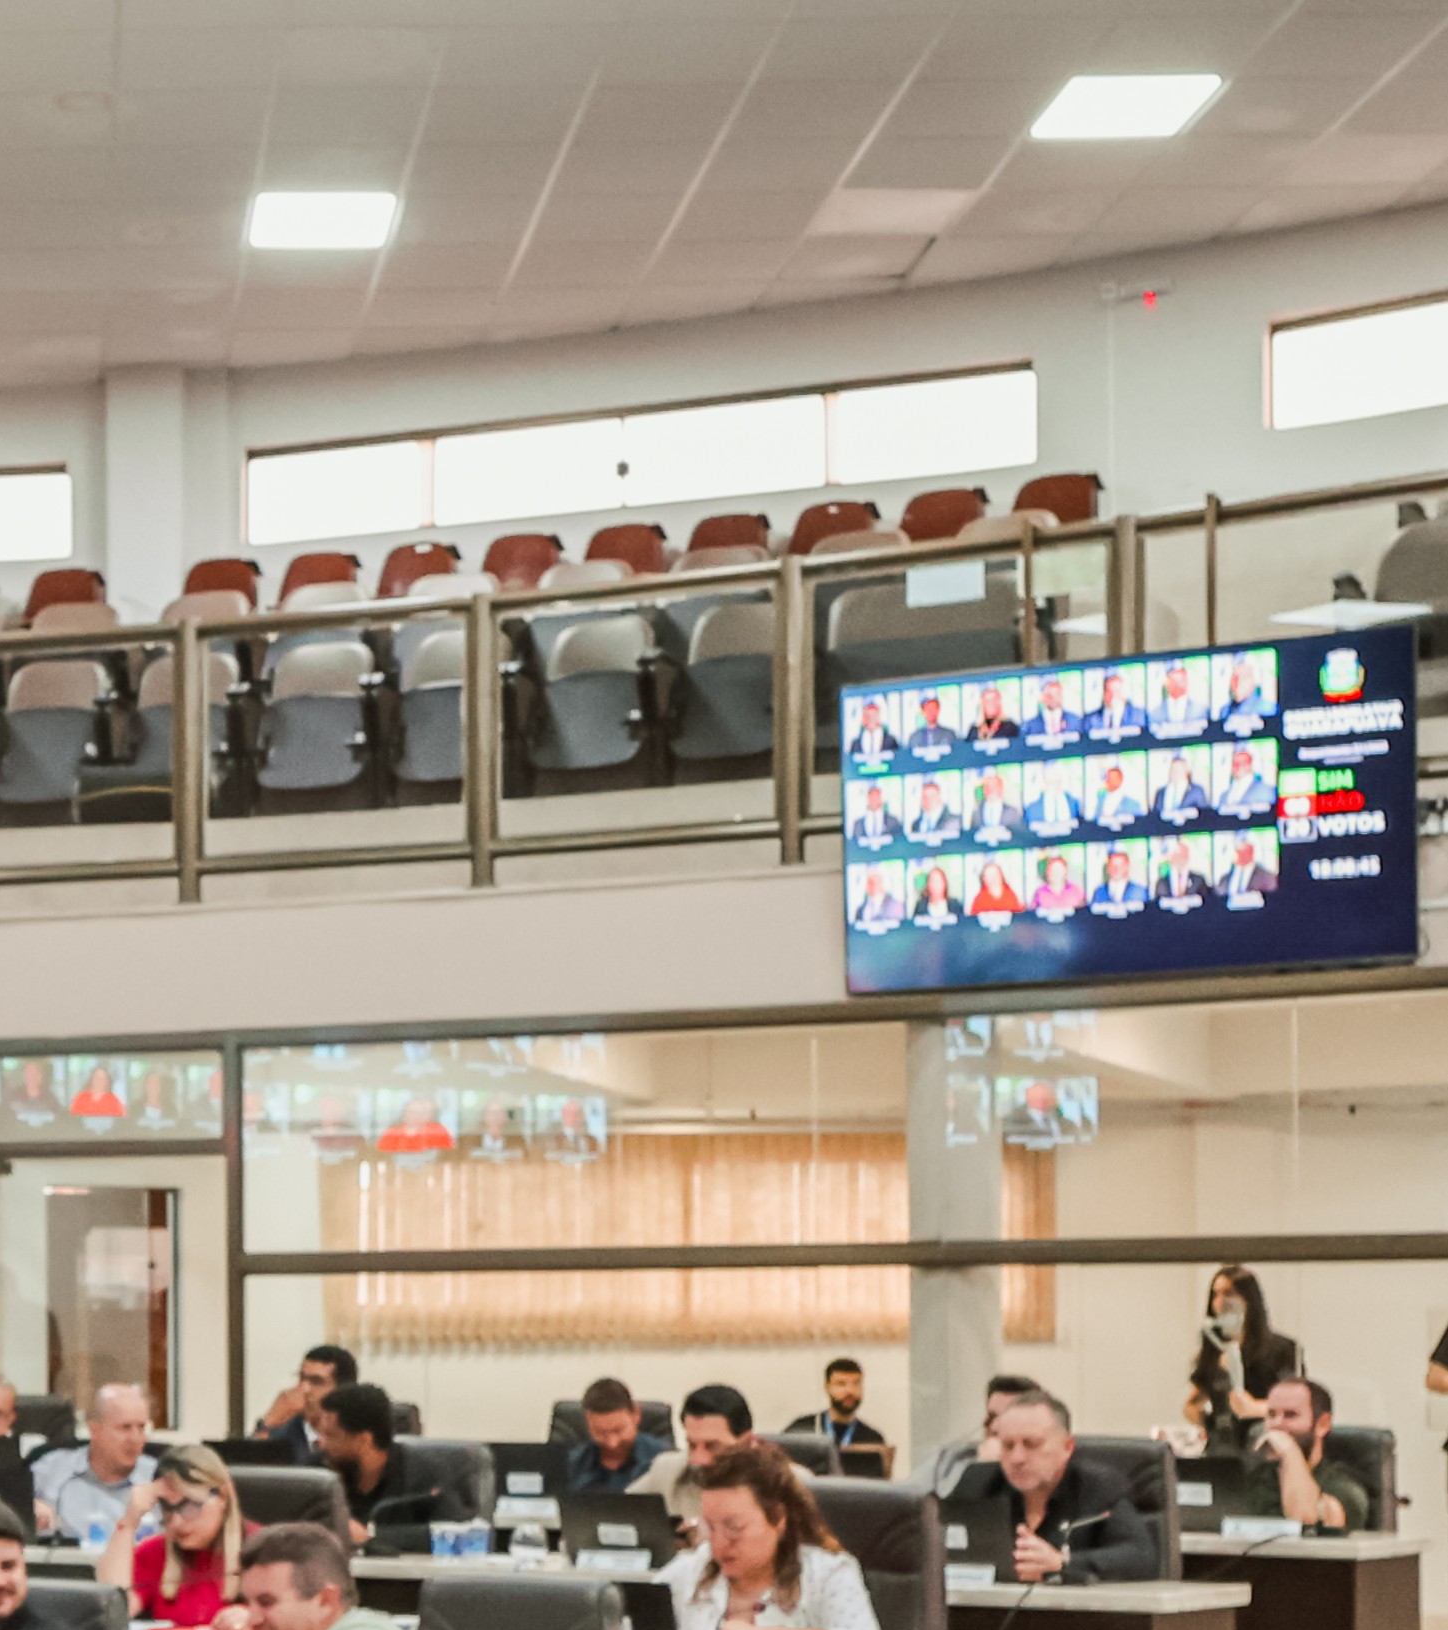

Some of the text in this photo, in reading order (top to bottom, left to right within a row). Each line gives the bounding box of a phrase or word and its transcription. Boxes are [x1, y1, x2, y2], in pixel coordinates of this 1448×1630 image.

[1317, 768, 1355, 792] SIM
[1317, 788, 1366, 814] NÃO
[1318, 810, 1387, 837] VOTOS
